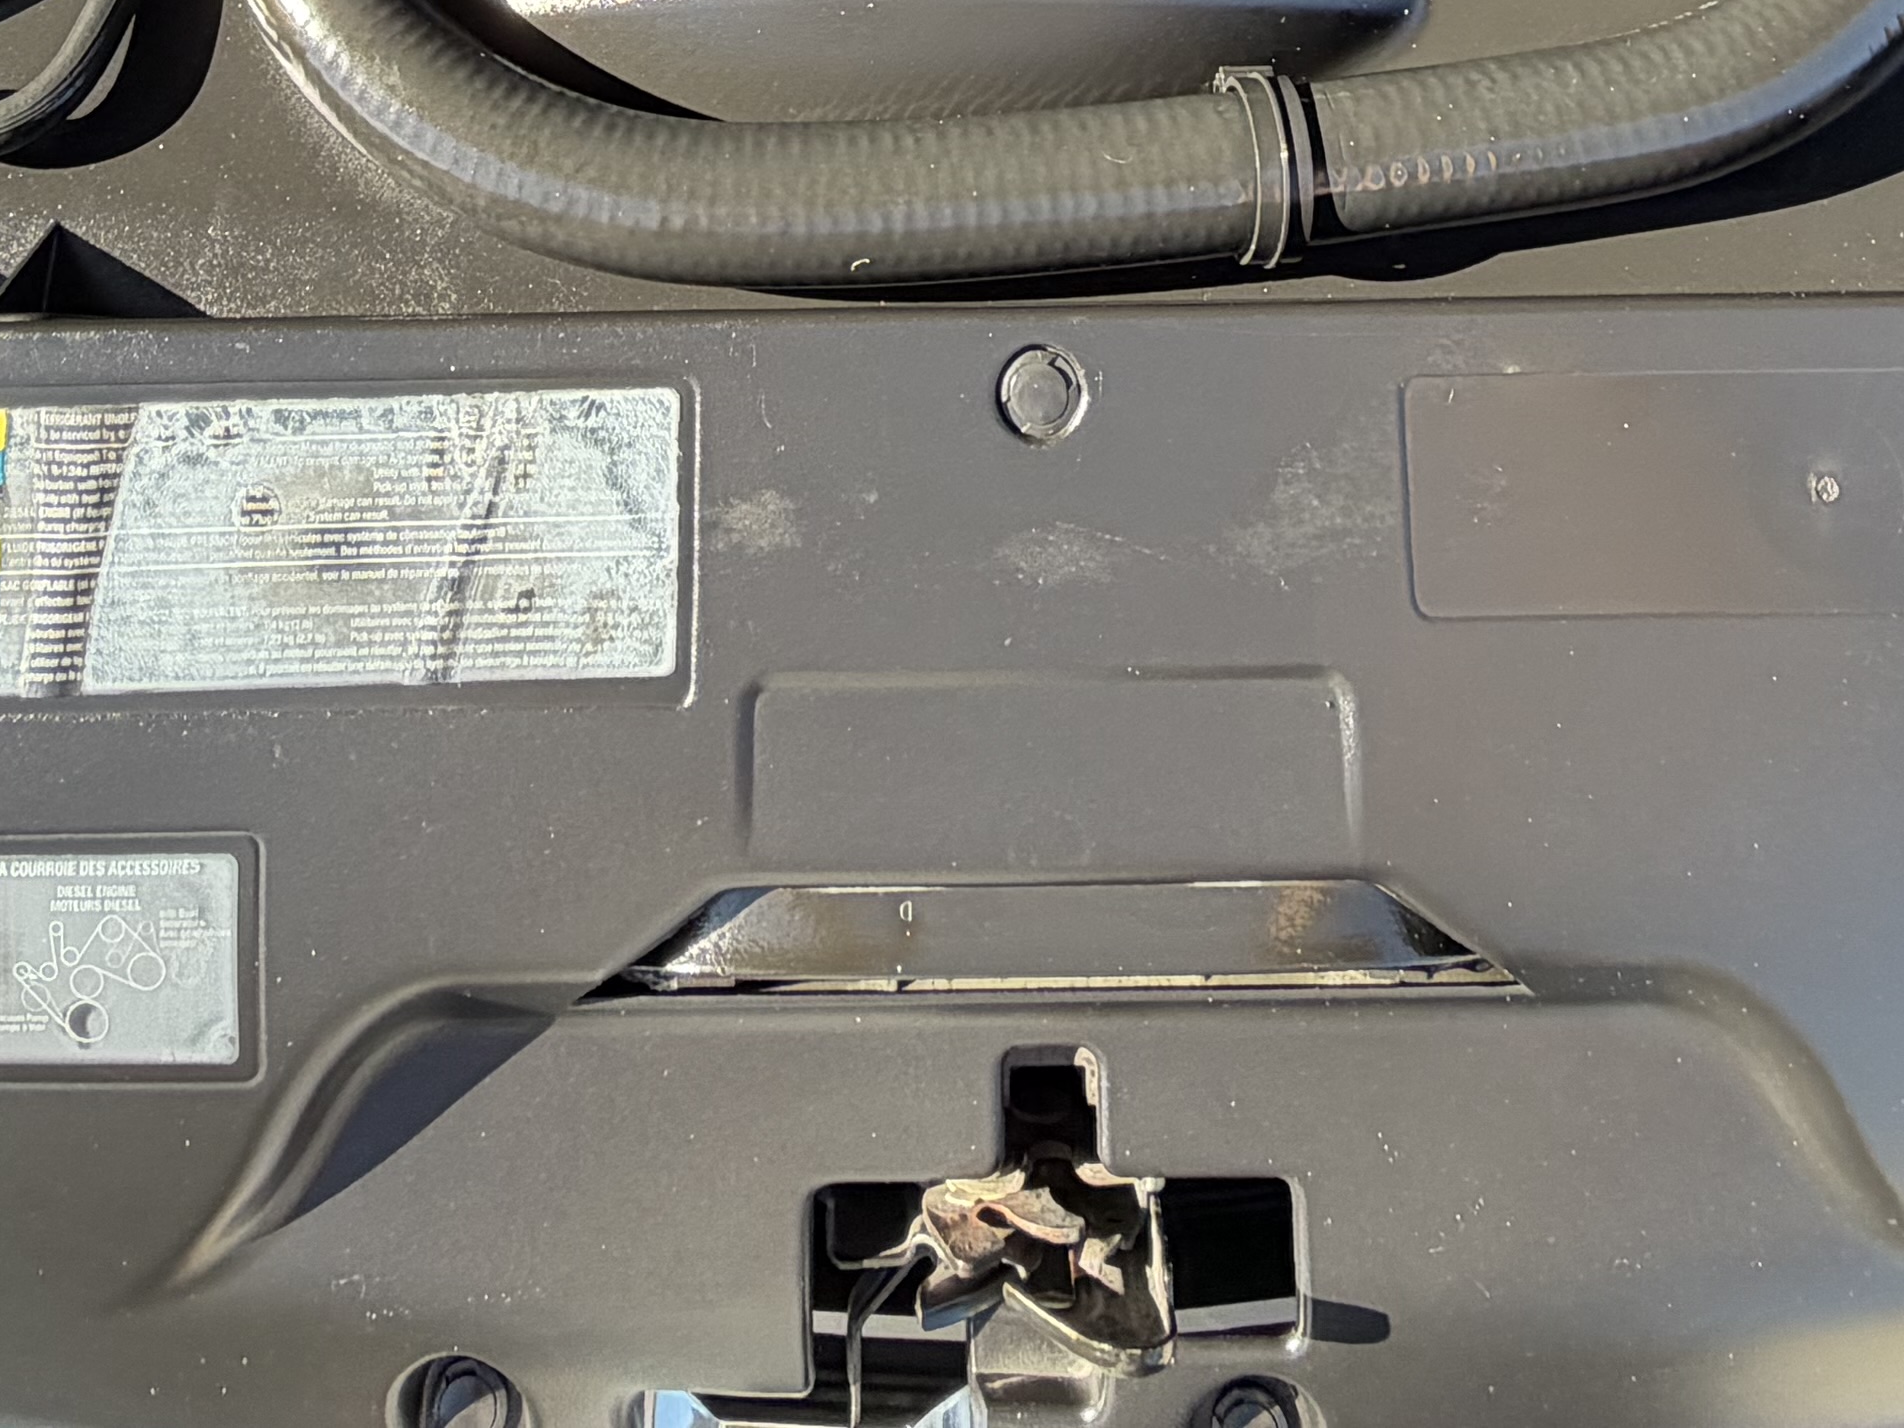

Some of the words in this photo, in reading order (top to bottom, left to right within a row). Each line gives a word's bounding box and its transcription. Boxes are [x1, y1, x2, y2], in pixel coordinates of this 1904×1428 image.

[9, 860, 77, 878] COURROIE
[78, 860, 106, 877] DES
[107, 858, 201, 877] ACCESSOIRES
[56, 884, 94, 899] DIESEL
[49, 898, 103, 913] MOTEURS
[103, 898, 142, 912] DIESEL
